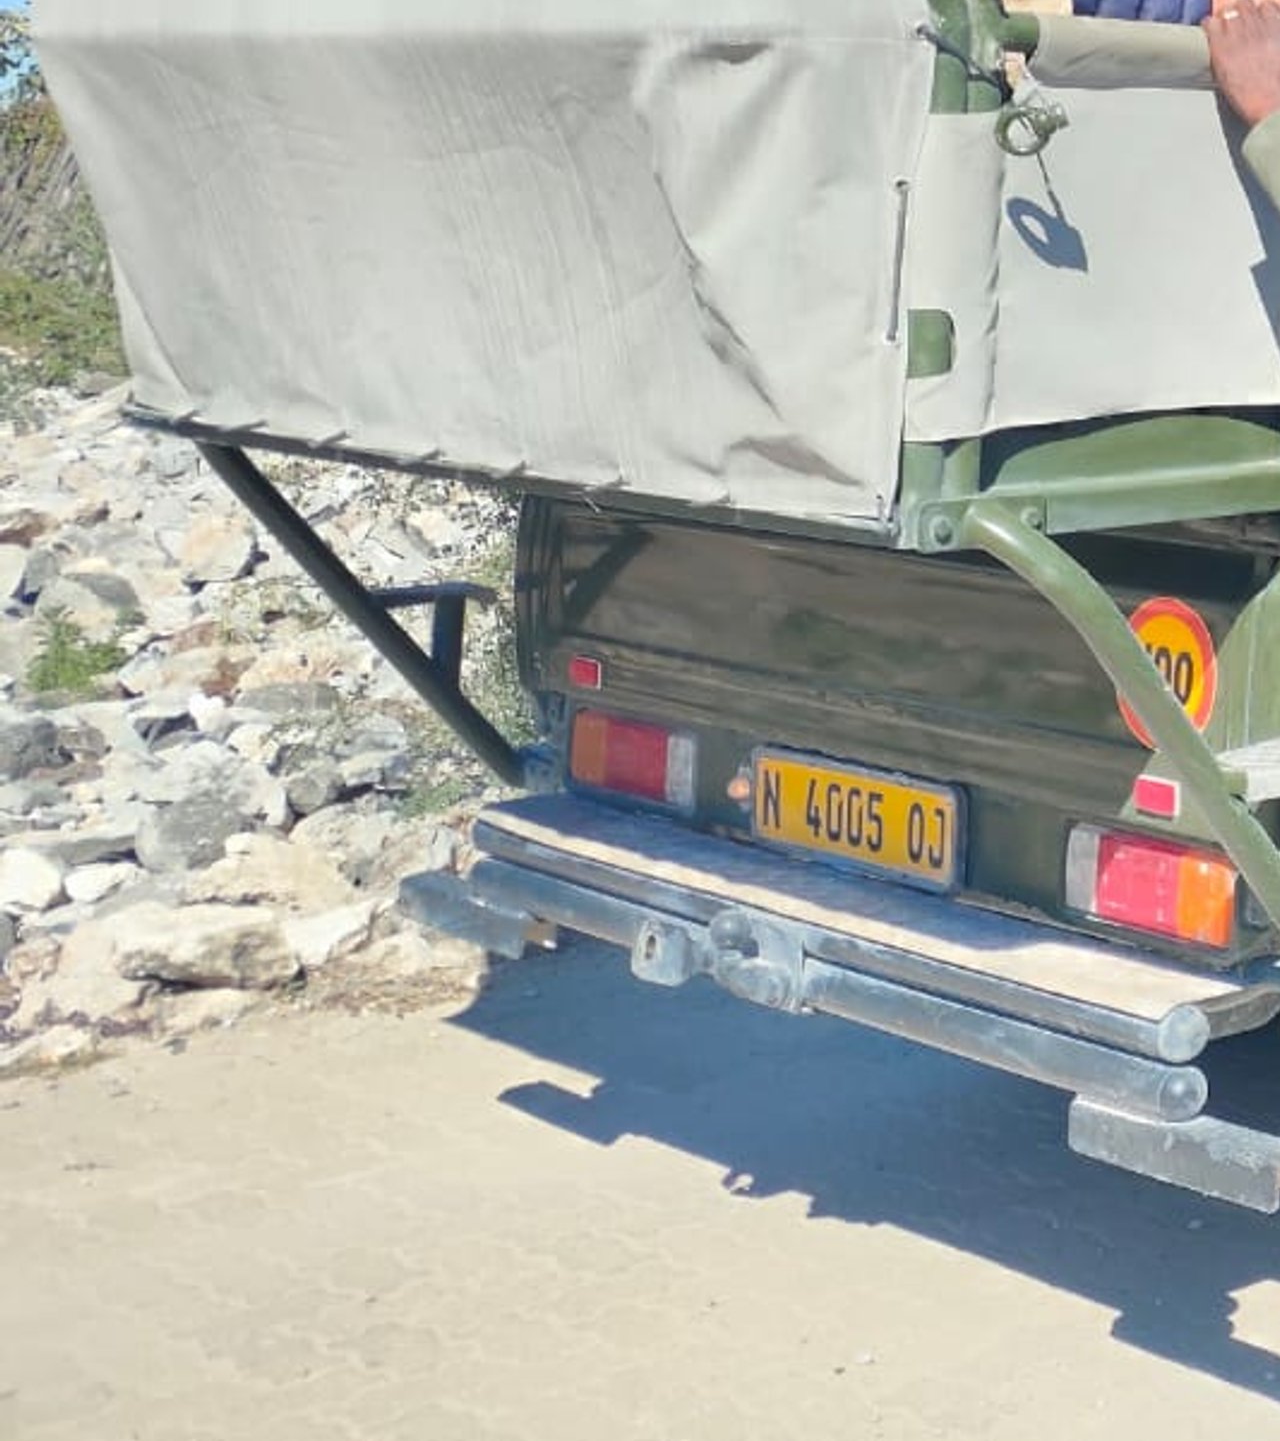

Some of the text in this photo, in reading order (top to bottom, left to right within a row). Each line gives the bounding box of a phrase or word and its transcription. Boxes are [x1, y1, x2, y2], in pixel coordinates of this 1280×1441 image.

[1145, 643, 1194, 706] 00
[763, 768, 781, 829] N
[805, 777, 883, 852] 4005
